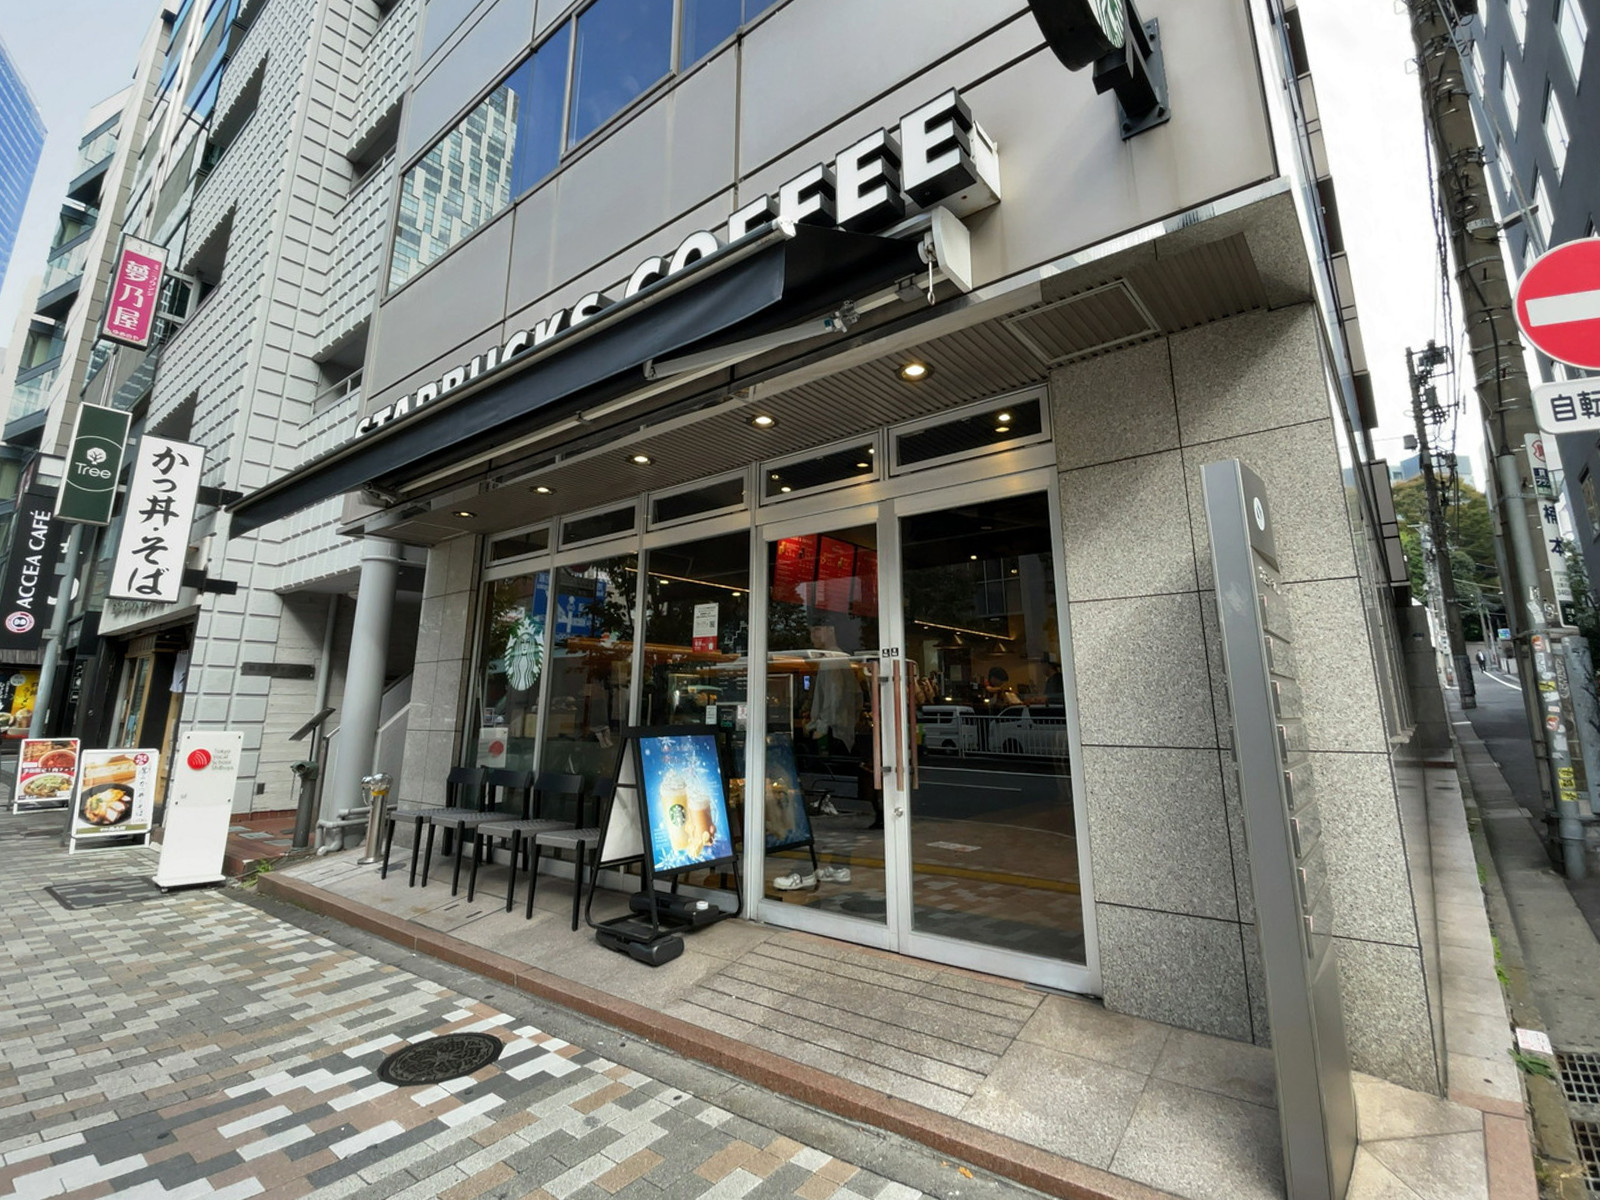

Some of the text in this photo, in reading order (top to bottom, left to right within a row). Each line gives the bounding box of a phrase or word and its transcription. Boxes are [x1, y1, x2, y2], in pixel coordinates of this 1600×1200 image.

[113, 260, 151, 331] 夢乃屋
[75, 462, 112, 480] Tree
[16, 509, 52, 609] ACCEA CAFÉ
